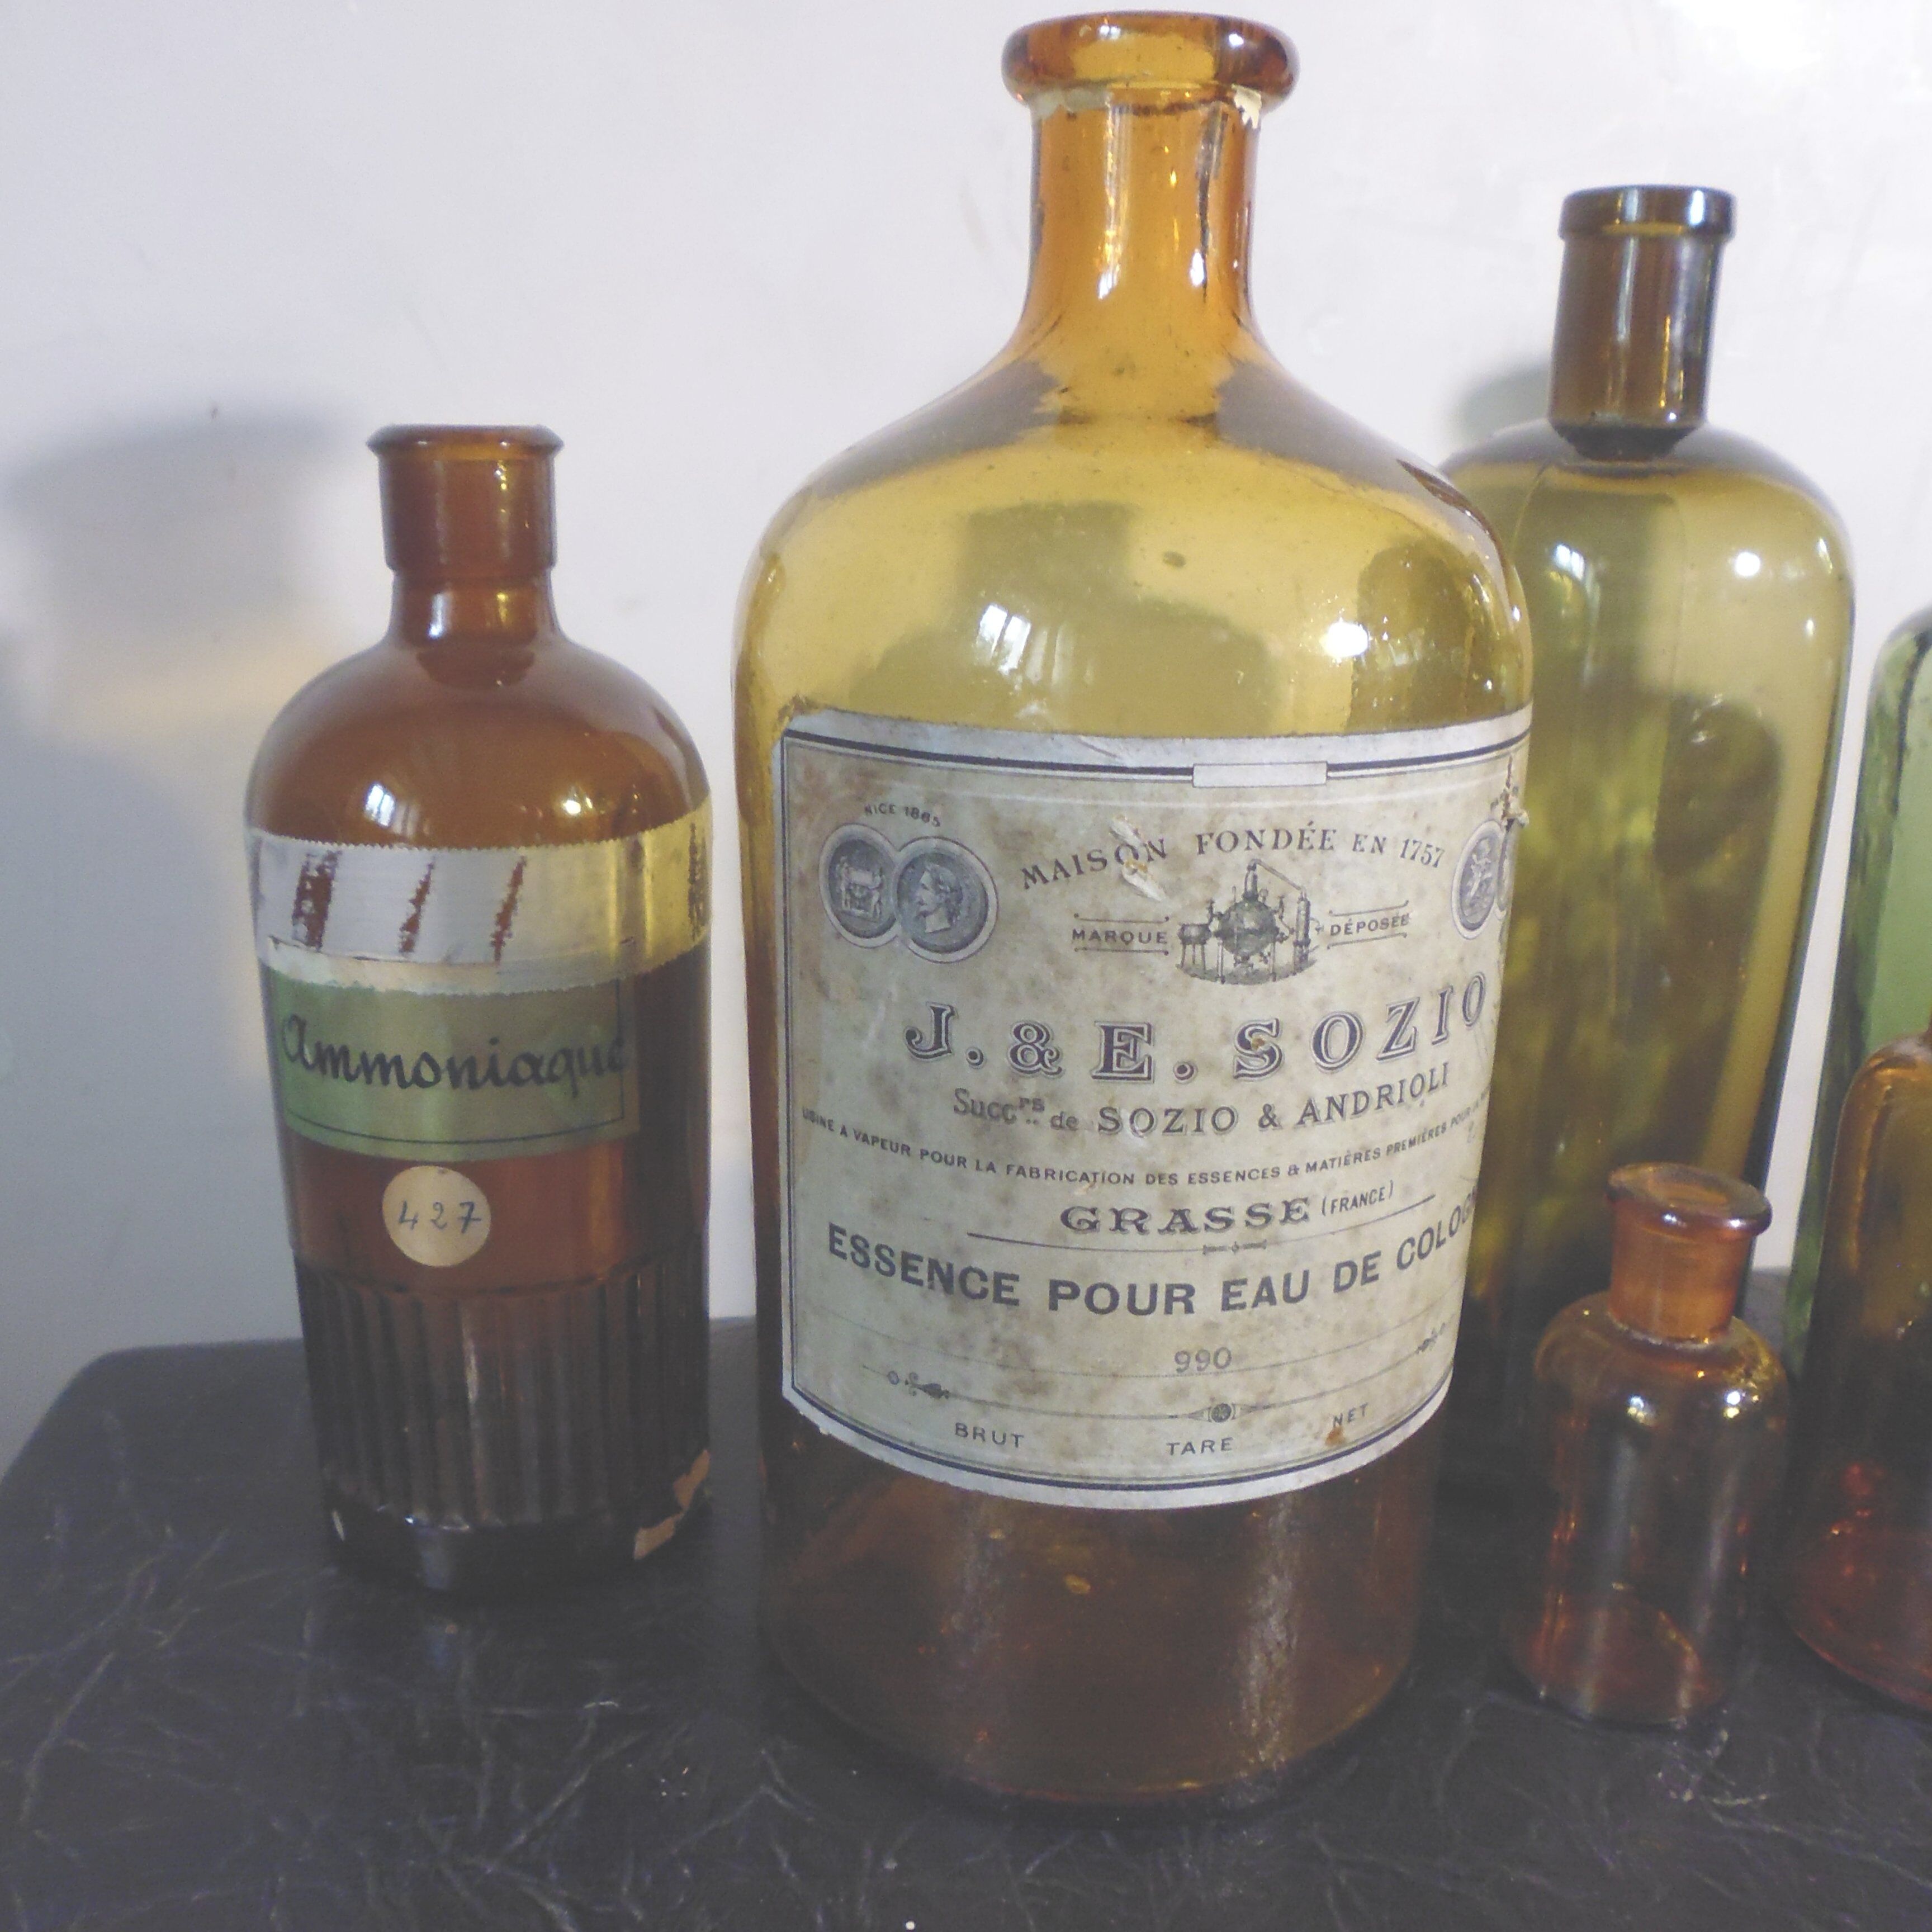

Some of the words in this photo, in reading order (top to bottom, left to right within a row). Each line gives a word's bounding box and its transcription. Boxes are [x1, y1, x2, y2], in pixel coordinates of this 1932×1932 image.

[864, 803, 896, 815] NICE
[1021, 839, 1168, 890] MAISON
[1196, 821, 1337, 855] FONDÉE
[1352, 833, 1387, 854] EN
[1400, 838, 1446, 869] 1757
[1072, 927, 1168, 945] MARQUE
[281, 1014, 626, 1098] Ammoniaque
[903, 1001, 984, 1069] J.
[1007, 1020, 1066, 1078] &
[1090, 1021, 1197, 1085] E.
[1233, 972, 1487, 1082] SOZIO
[1050, 1111, 1079, 1131] de
[1097, 1105, 1237, 1137] SOZIO
[1257, 1103, 1282, 1130] &
[1296, 1062, 1450, 1127] ANDRIOLI
[802, 1106, 835, 1132] USINE
[853, 1128, 911, 1157] VAPEUR
[920, 1148, 968, 1168] POUR
[975, 1159, 997, 1174] LA
[1006, 1163, 1135, 1186] FABRICATION
[1145, 1172, 1178, 1186] DES
[1187, 1166, 1281, 1186] ESSENCES
[1287, 1164, 1300, 1176] &
[1305, 1147, 1381, 1173] MATIÈRES
[397, 1200, 482, 1234] 427
[1060, 1196, 1310, 1235] GRASSE
[1320, 1179, 1394, 1216] (FRANCE)
[828, 1222, 1020, 1306] ESSENCE
[1048, 1278, 1196, 1316] POUR
[1221, 1269, 1310, 1312] EAU
[1333, 1251, 1382, 1294] DE
[1175, 1346, 1233, 1374] 990
[954, 1421, 1024, 1448] BRUT
[1166, 1437, 1234, 1456] TARE
[1332, 1403, 1370, 1427] NET
